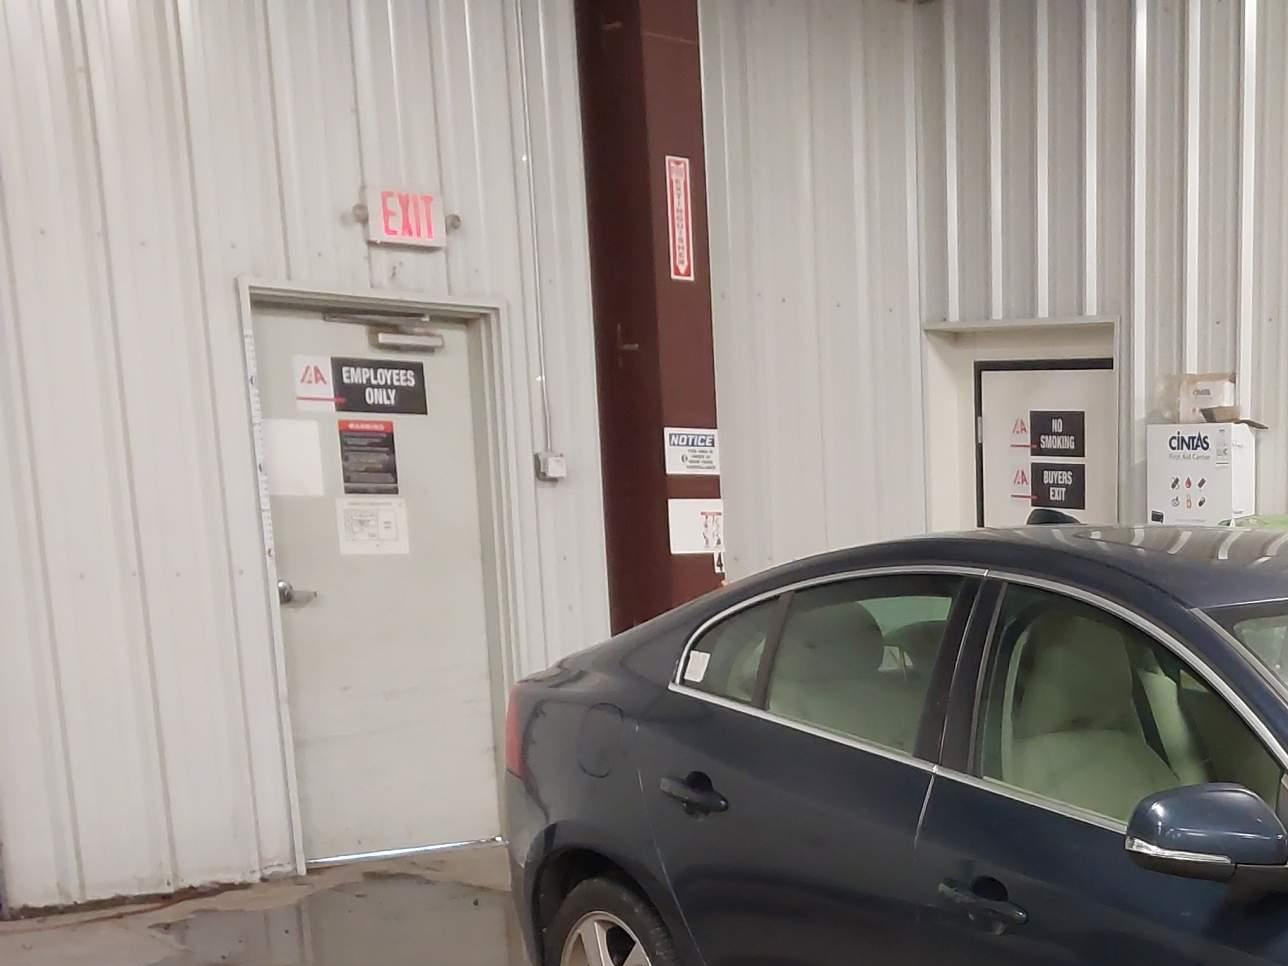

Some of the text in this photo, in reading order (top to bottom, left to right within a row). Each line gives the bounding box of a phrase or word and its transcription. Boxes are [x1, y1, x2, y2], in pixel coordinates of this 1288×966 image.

[381, 191, 434, 239] EXIT
[341, 366, 416, 387] EMPLOYEES
[365, 387, 396, 405] ONLY
[1051, 418, 1063, 433] NO
[670, 434, 714, 447] NOTICE
[1040, 434, 1075, 449] SMOKING
[1043, 470, 1073, 485] BUYERS
[1049, 487, 1066, 501] EXIT
